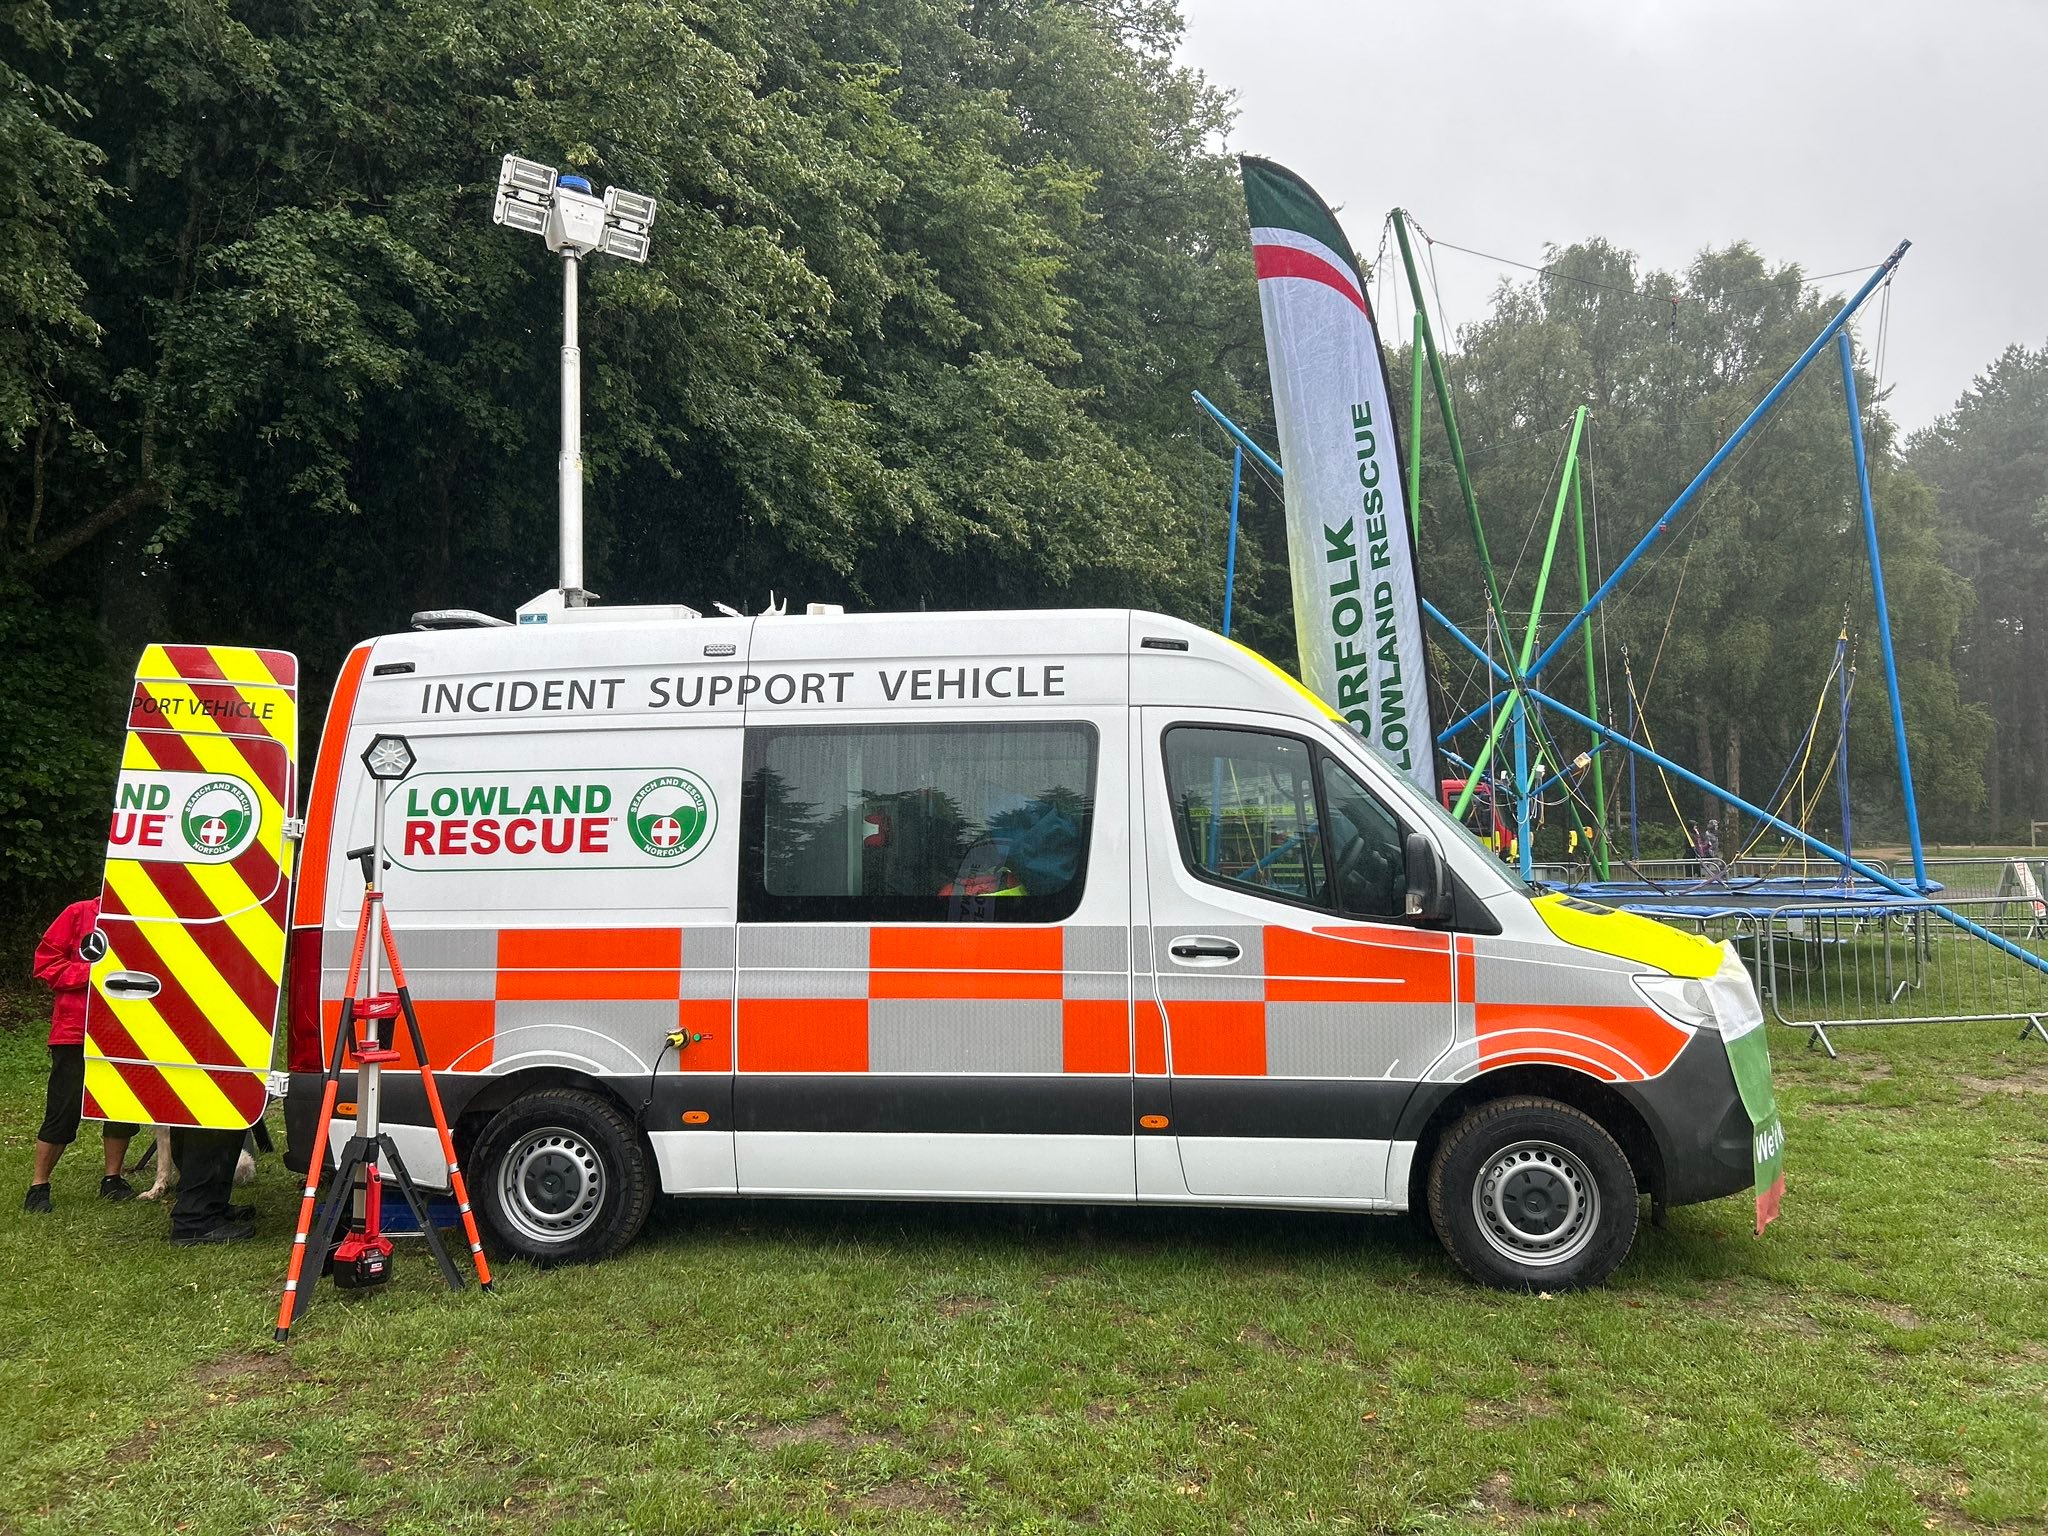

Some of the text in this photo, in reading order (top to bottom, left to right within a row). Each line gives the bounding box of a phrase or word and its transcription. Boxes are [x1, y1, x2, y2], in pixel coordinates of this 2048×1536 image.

[1351, 400, 1412, 771] LOWLAND RESCUE
[421, 665, 1065, 714] INCIDENT SUPPORT VEHICLE
[131, 697, 275, 719] PORT VEHICLE
[114, 783, 171, 811] ND
[185, 785, 211, 812] SEARCH
[231, 786, 251, 816] RESCUE
[407, 784, 612, 817] LOWLAND
[630, 778, 705, 813] SEARCH AND RESCUE
[192, 841, 231, 854] NORFOLK
[404, 817, 610, 856] RESCUE
[643, 843, 687, 857] NORFOLK
